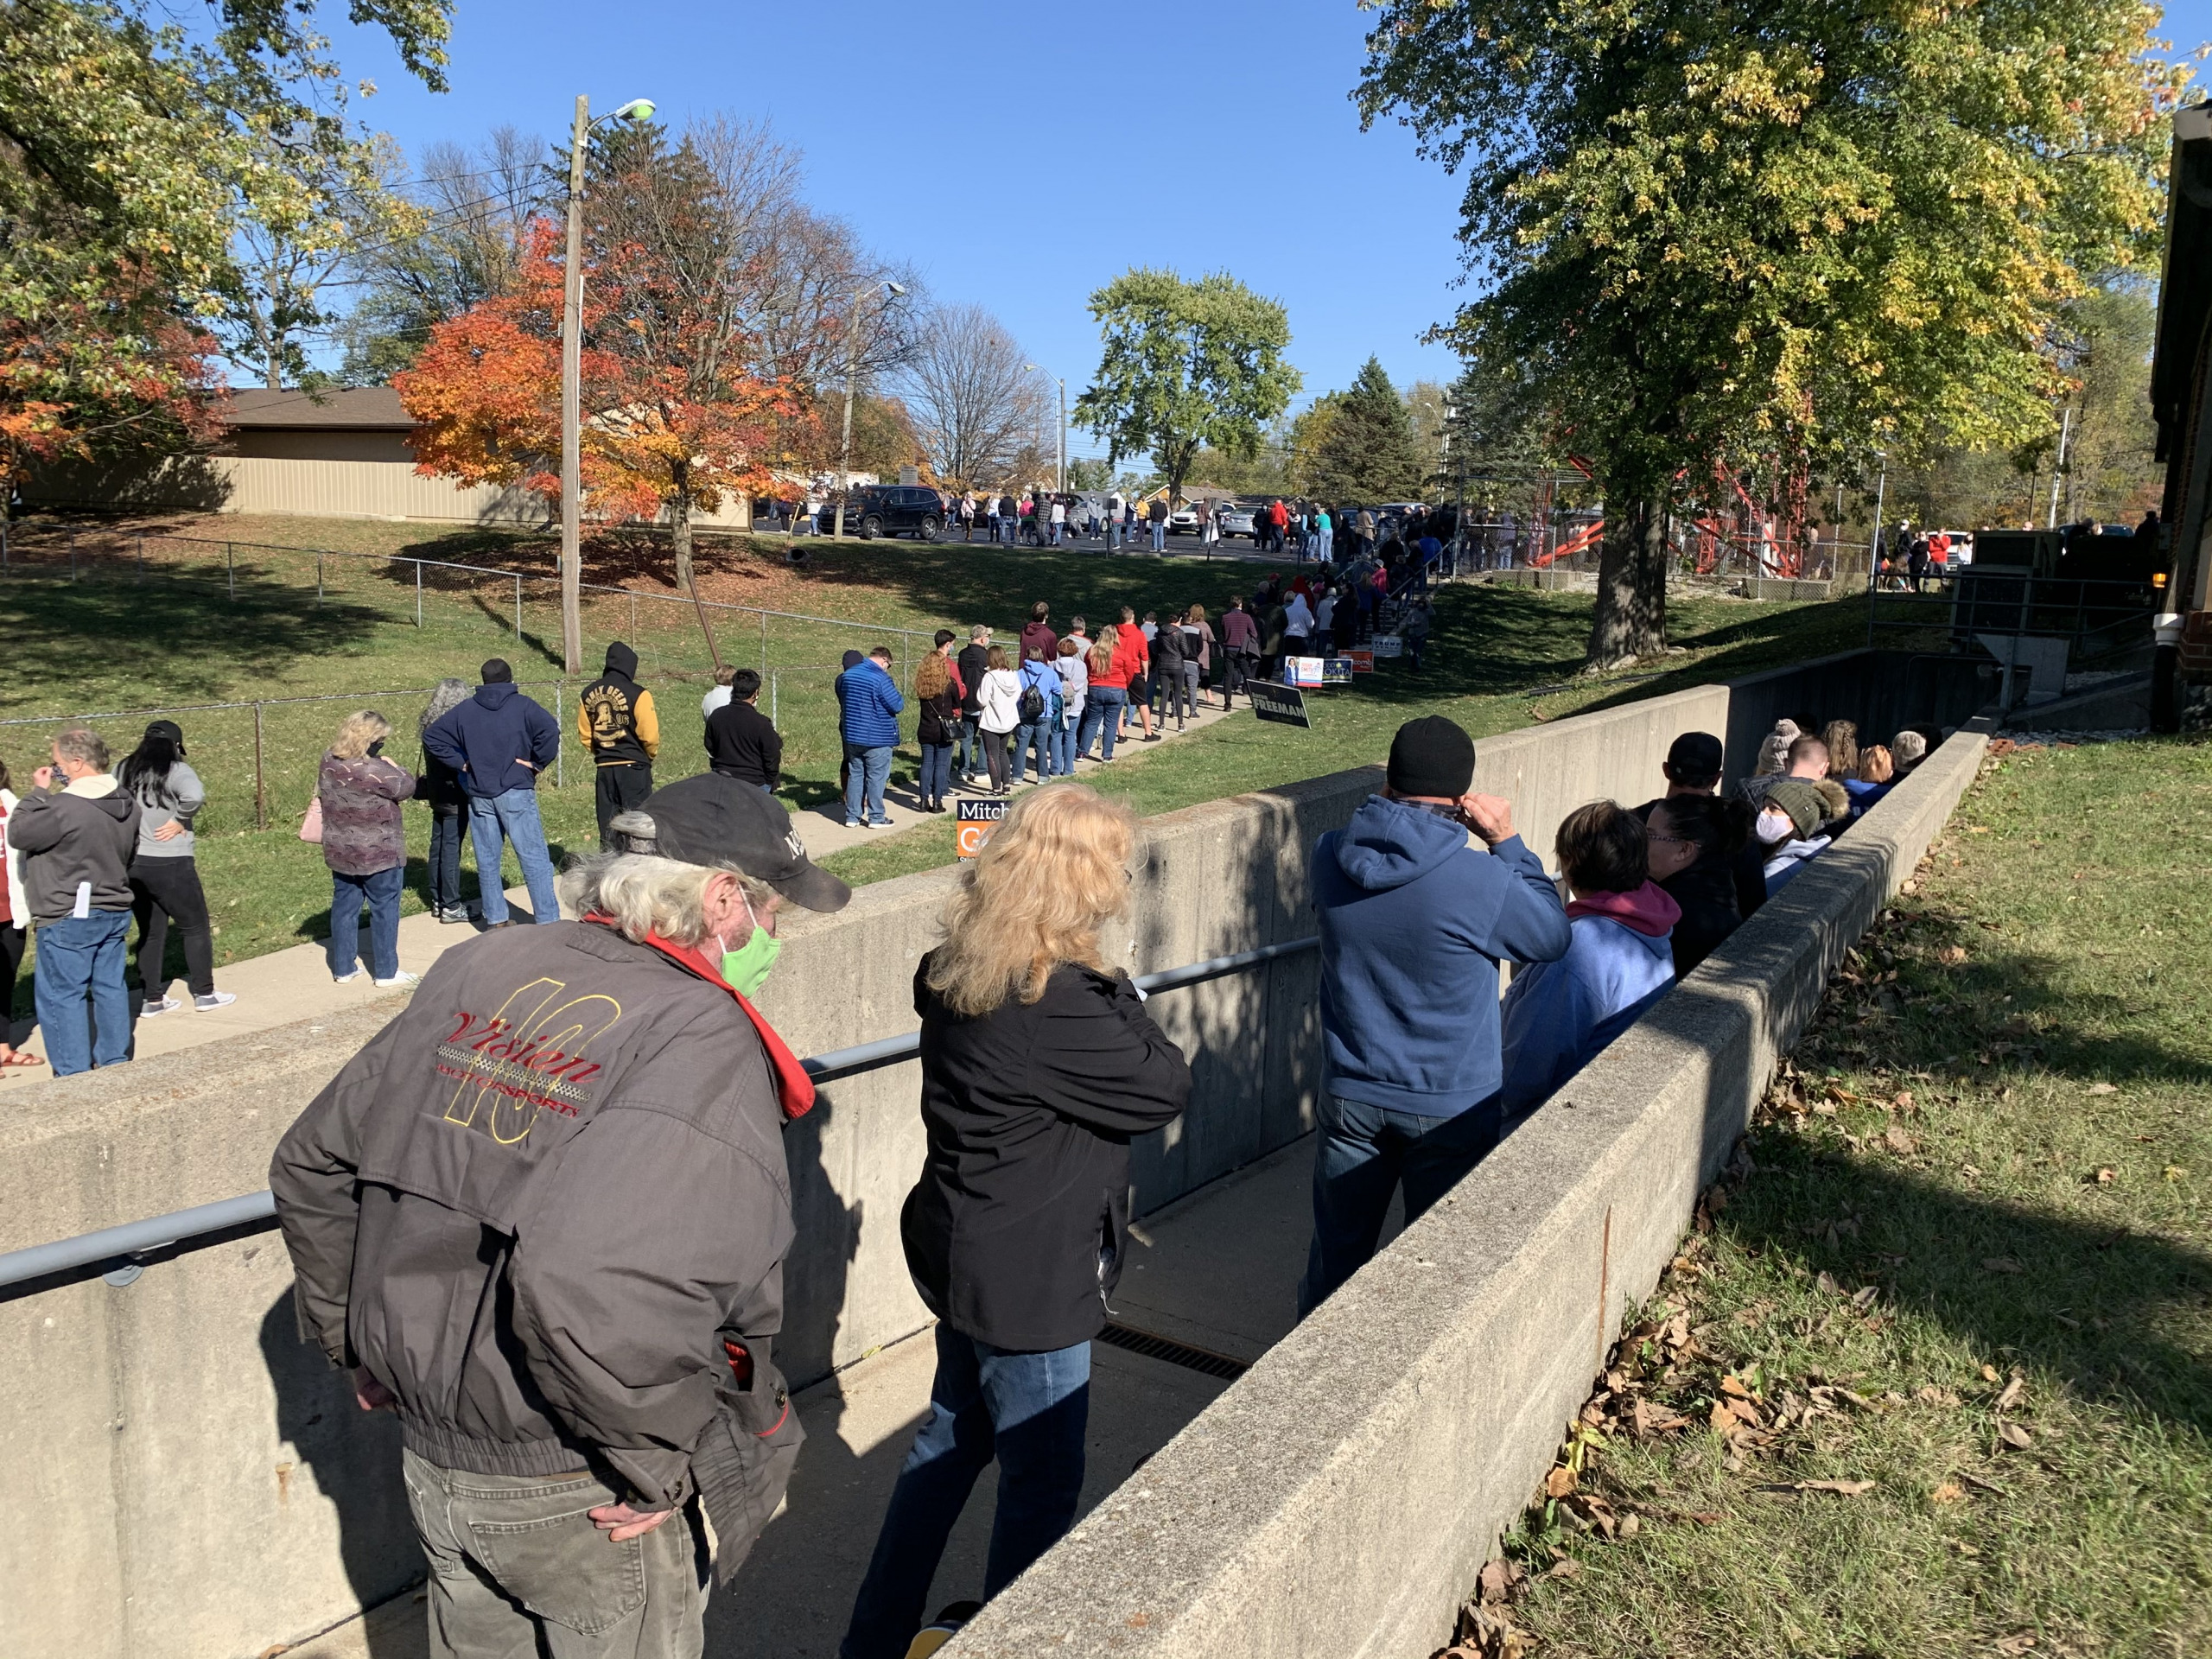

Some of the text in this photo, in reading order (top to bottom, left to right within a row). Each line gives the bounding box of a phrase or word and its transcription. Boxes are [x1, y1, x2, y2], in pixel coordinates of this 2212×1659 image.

[607, 685, 629, 711] DEEDS
[1253, 697, 1306, 719] FREEMAN
[444, 1011, 603, 1084] Vision
[435, 1063, 582, 1119] MOTORSPORTS
